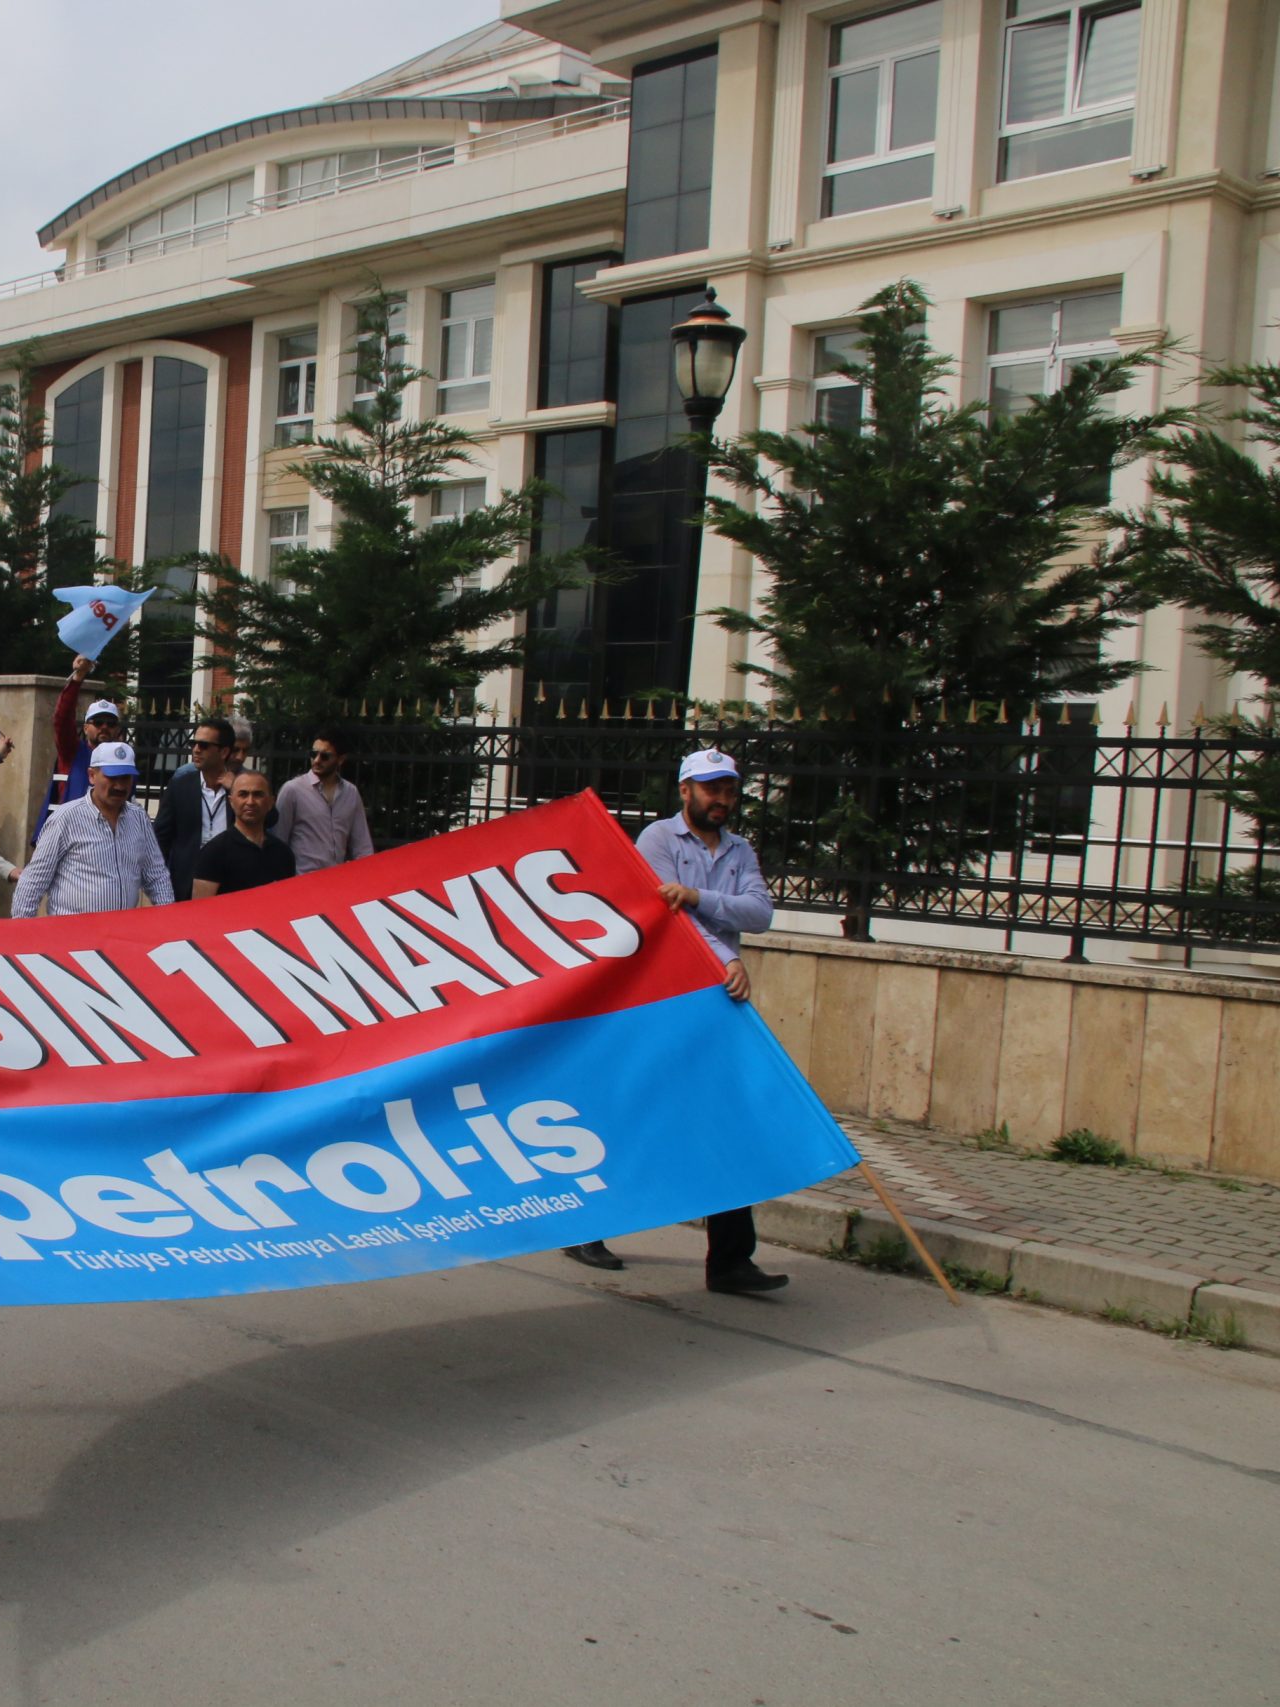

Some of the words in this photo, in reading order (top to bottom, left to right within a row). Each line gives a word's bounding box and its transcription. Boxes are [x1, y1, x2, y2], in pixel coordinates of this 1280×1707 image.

[147, 940, 293, 1049] 1
[223, 849, 644, 1036] MAYIS
[53, 1249, 171, 1273] Türkiye
[165, 1243, 255, 1266] Petrol
[247, 1233, 336, 1259] Kimya
[328, 1224, 411, 1250] Lastik
[396, 1216, 485, 1243] İşçileri
[478, 1192, 585, 1226] Sendikası
